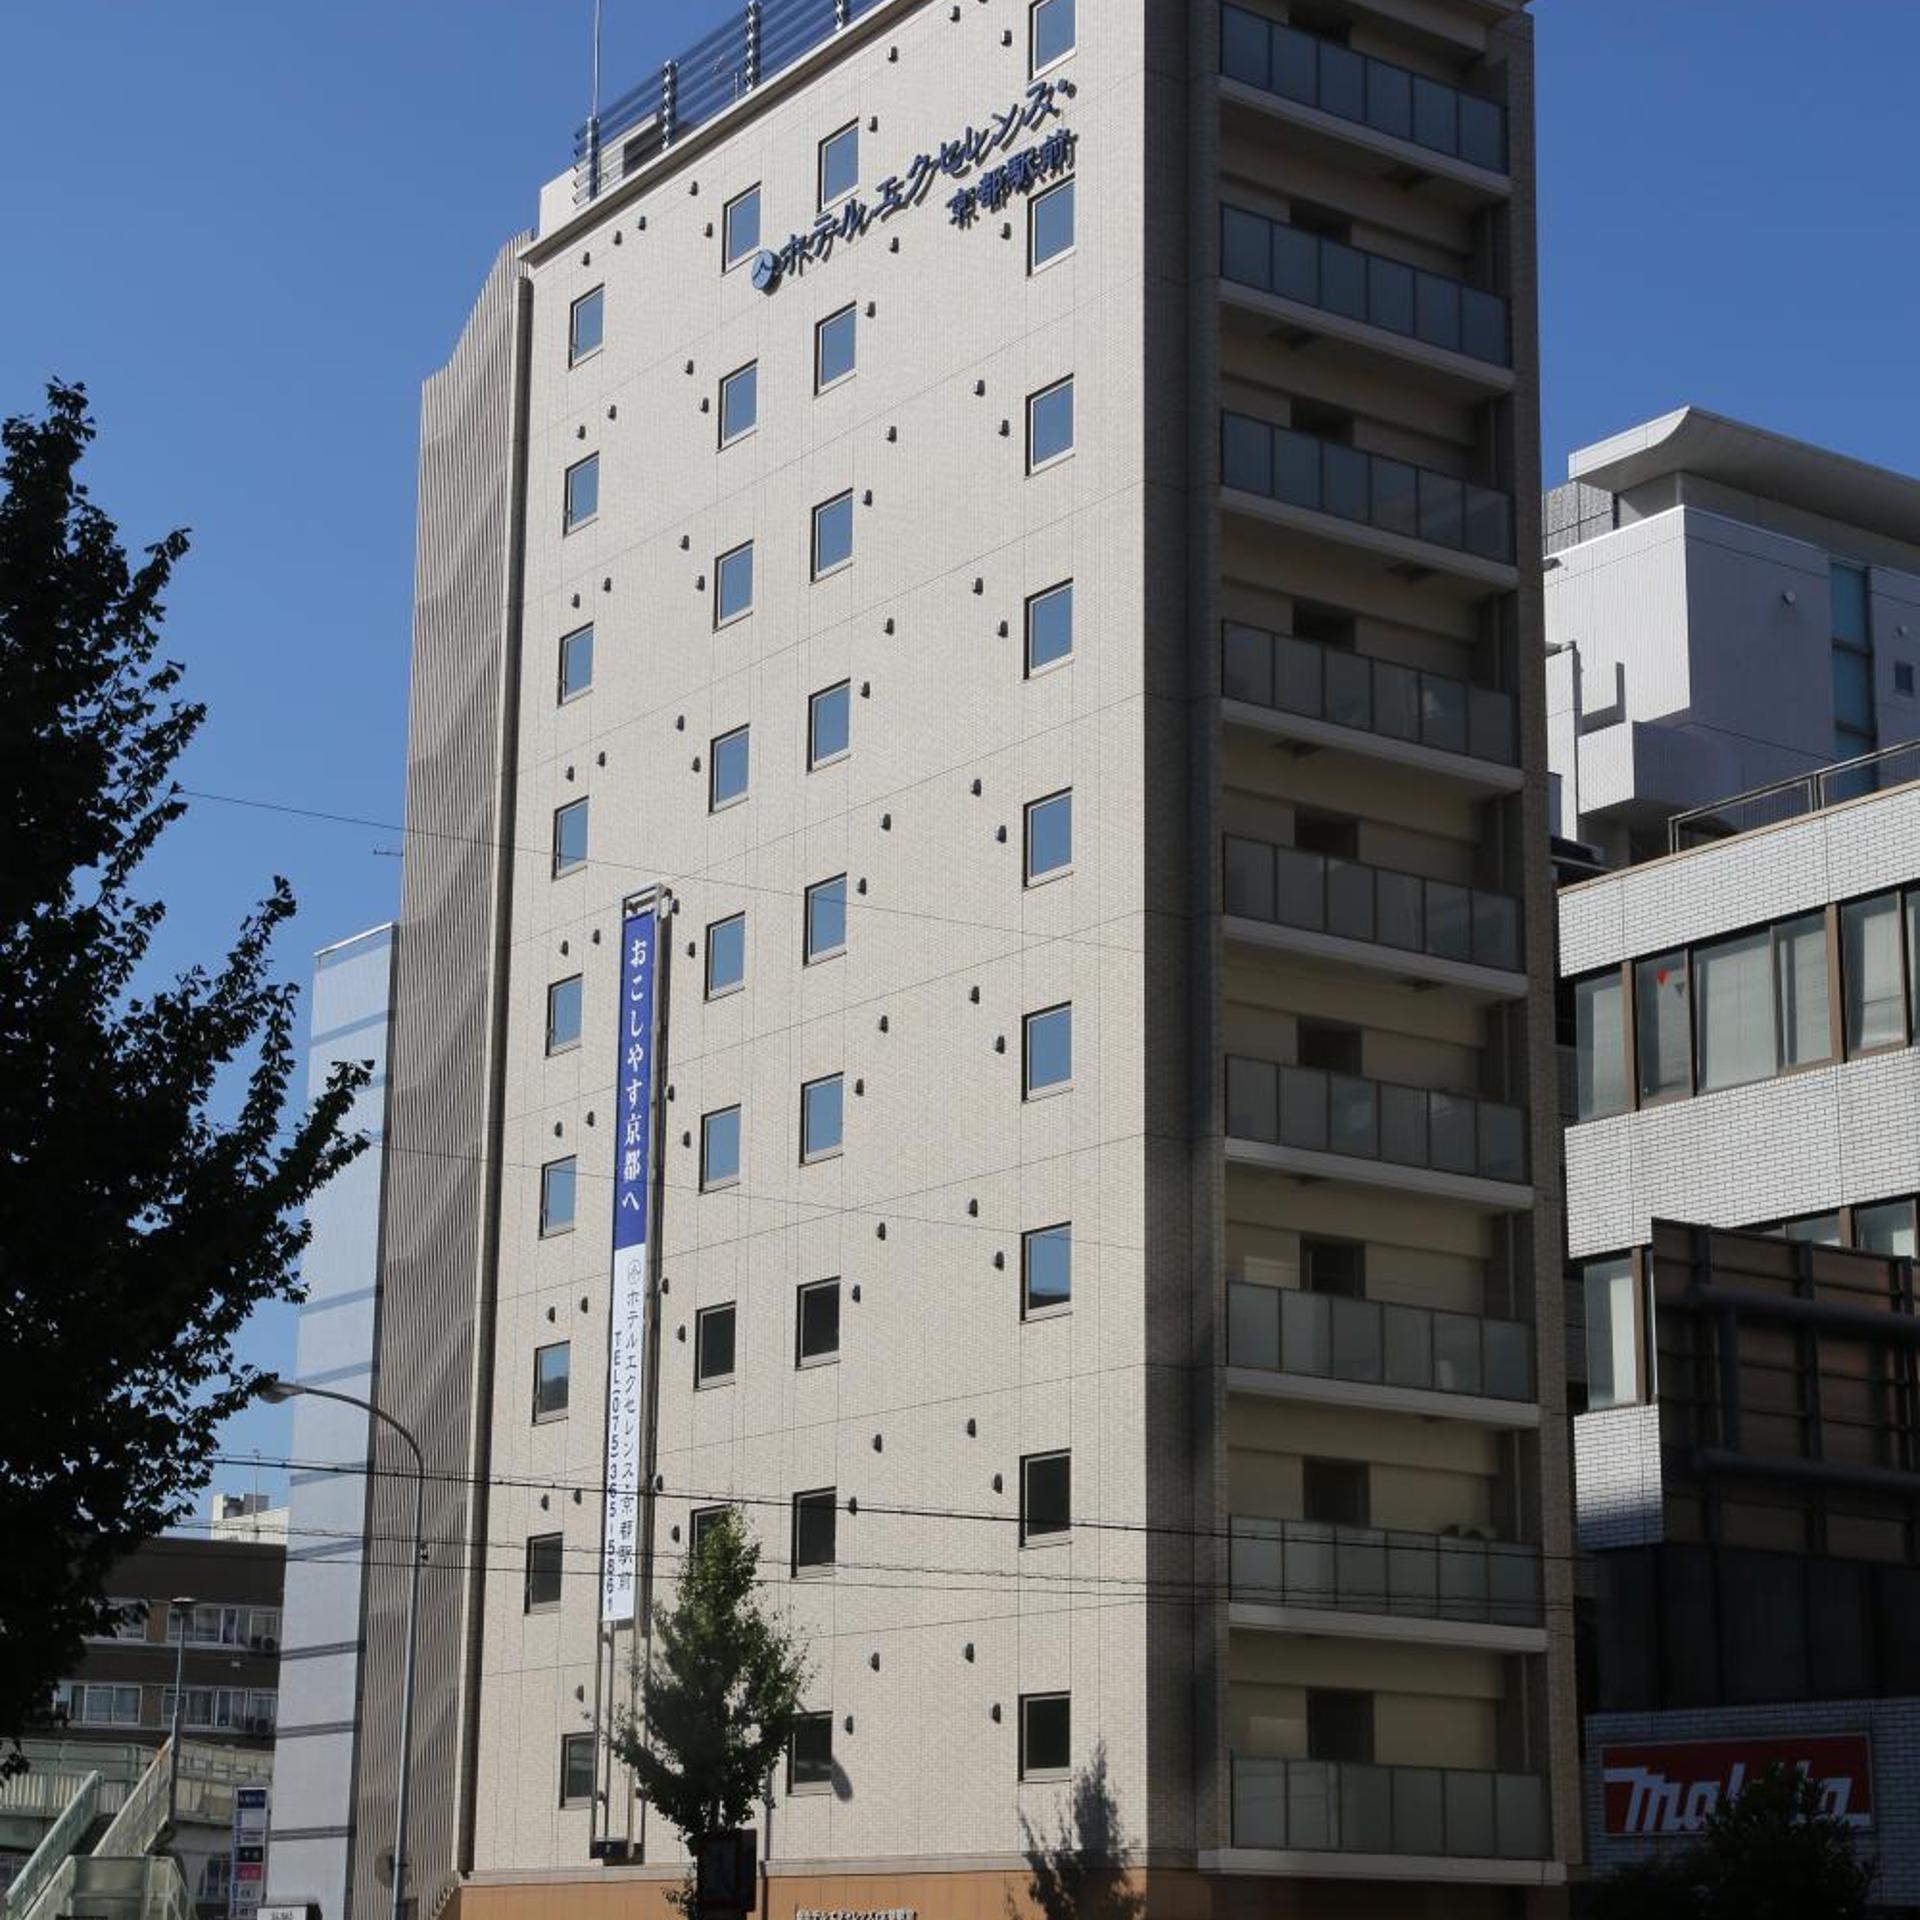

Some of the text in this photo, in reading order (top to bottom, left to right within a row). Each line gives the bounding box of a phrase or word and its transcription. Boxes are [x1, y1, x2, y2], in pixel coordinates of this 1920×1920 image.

[622, 939, 647, 1210] おこしやす京都へ
